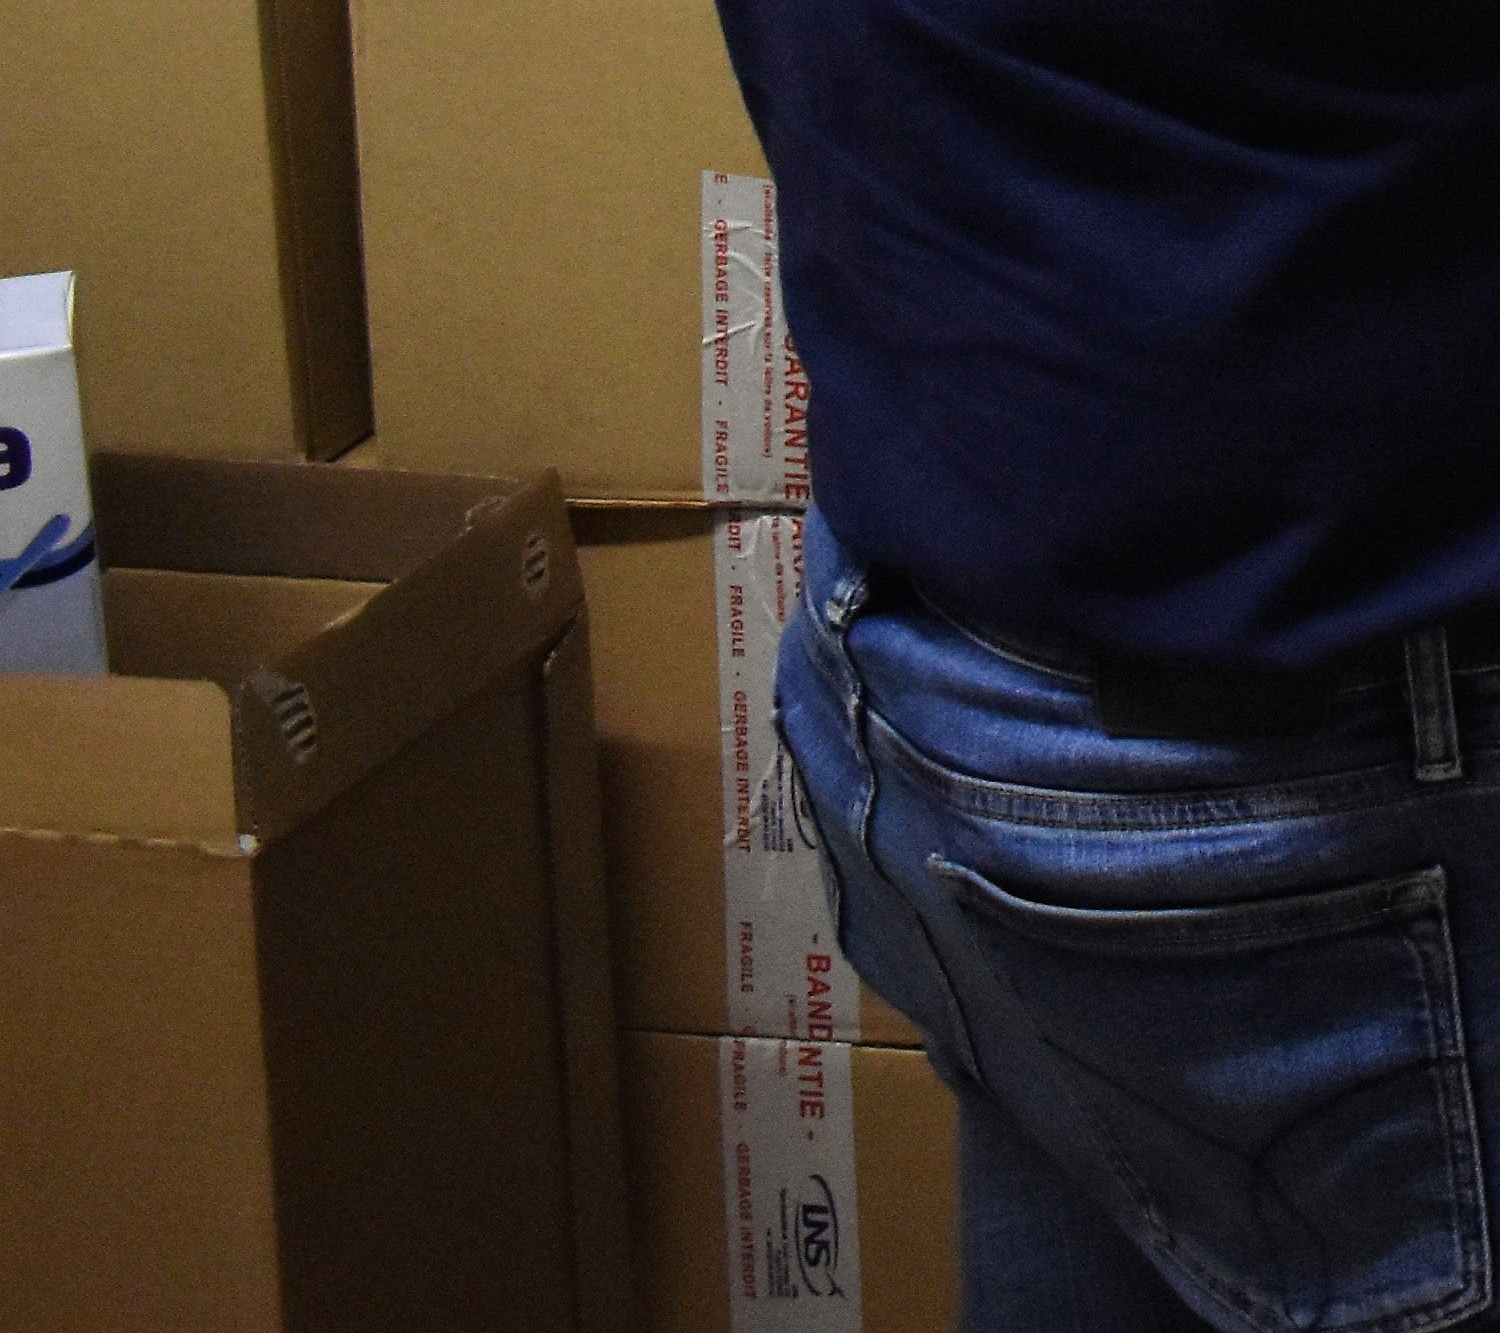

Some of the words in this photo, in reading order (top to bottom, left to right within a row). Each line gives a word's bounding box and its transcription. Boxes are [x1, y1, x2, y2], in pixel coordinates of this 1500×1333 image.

[714, 219, 729, 303] GERBAGE
[714, 309, 729, 386] INTERDIT
[714, 420, 729, 494] FRAGILE
[730, 584, 745, 658] FRAGILE
[732, 689, 749, 772] GERBAGE
[735, 778, 752, 853] INTERDIT
[739, 921, 754, 994] FRAGILE
[735, 1142, 752, 1221] GERBAGE
[739, 1226, 757, 1300] INTERDIT
[802, 1203, 831, 1269] LNS
